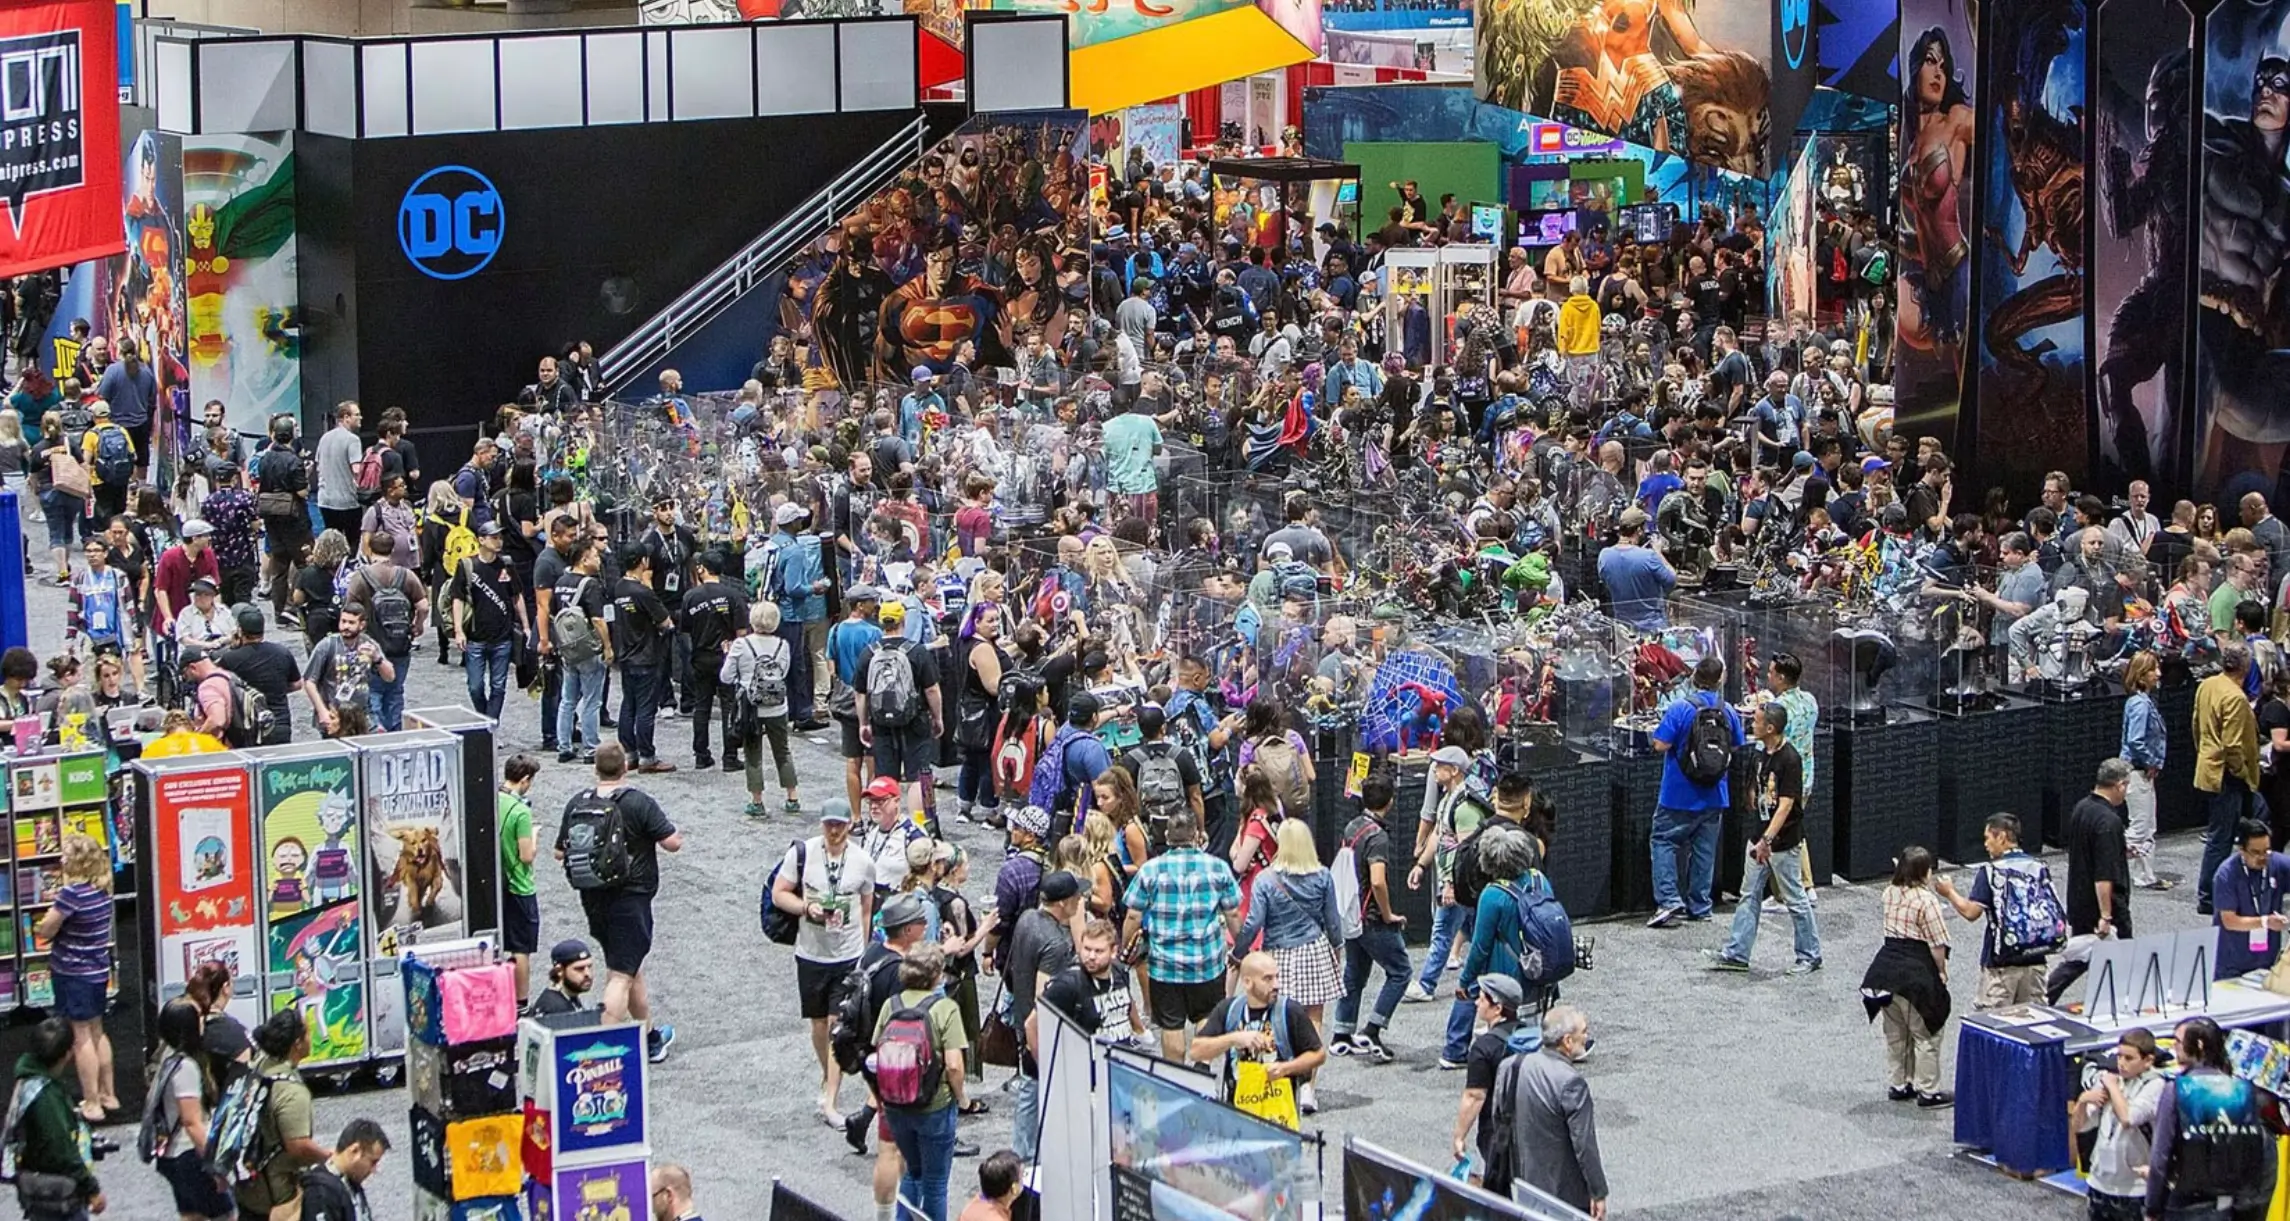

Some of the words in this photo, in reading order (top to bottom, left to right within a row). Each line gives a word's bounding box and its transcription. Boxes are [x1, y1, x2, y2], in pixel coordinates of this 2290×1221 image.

[401, 190, 496, 259] DC
[381, 749, 447, 797] DEAD
[382, 795, 398, 815] OF
[399, 790, 448, 814] WINTER
